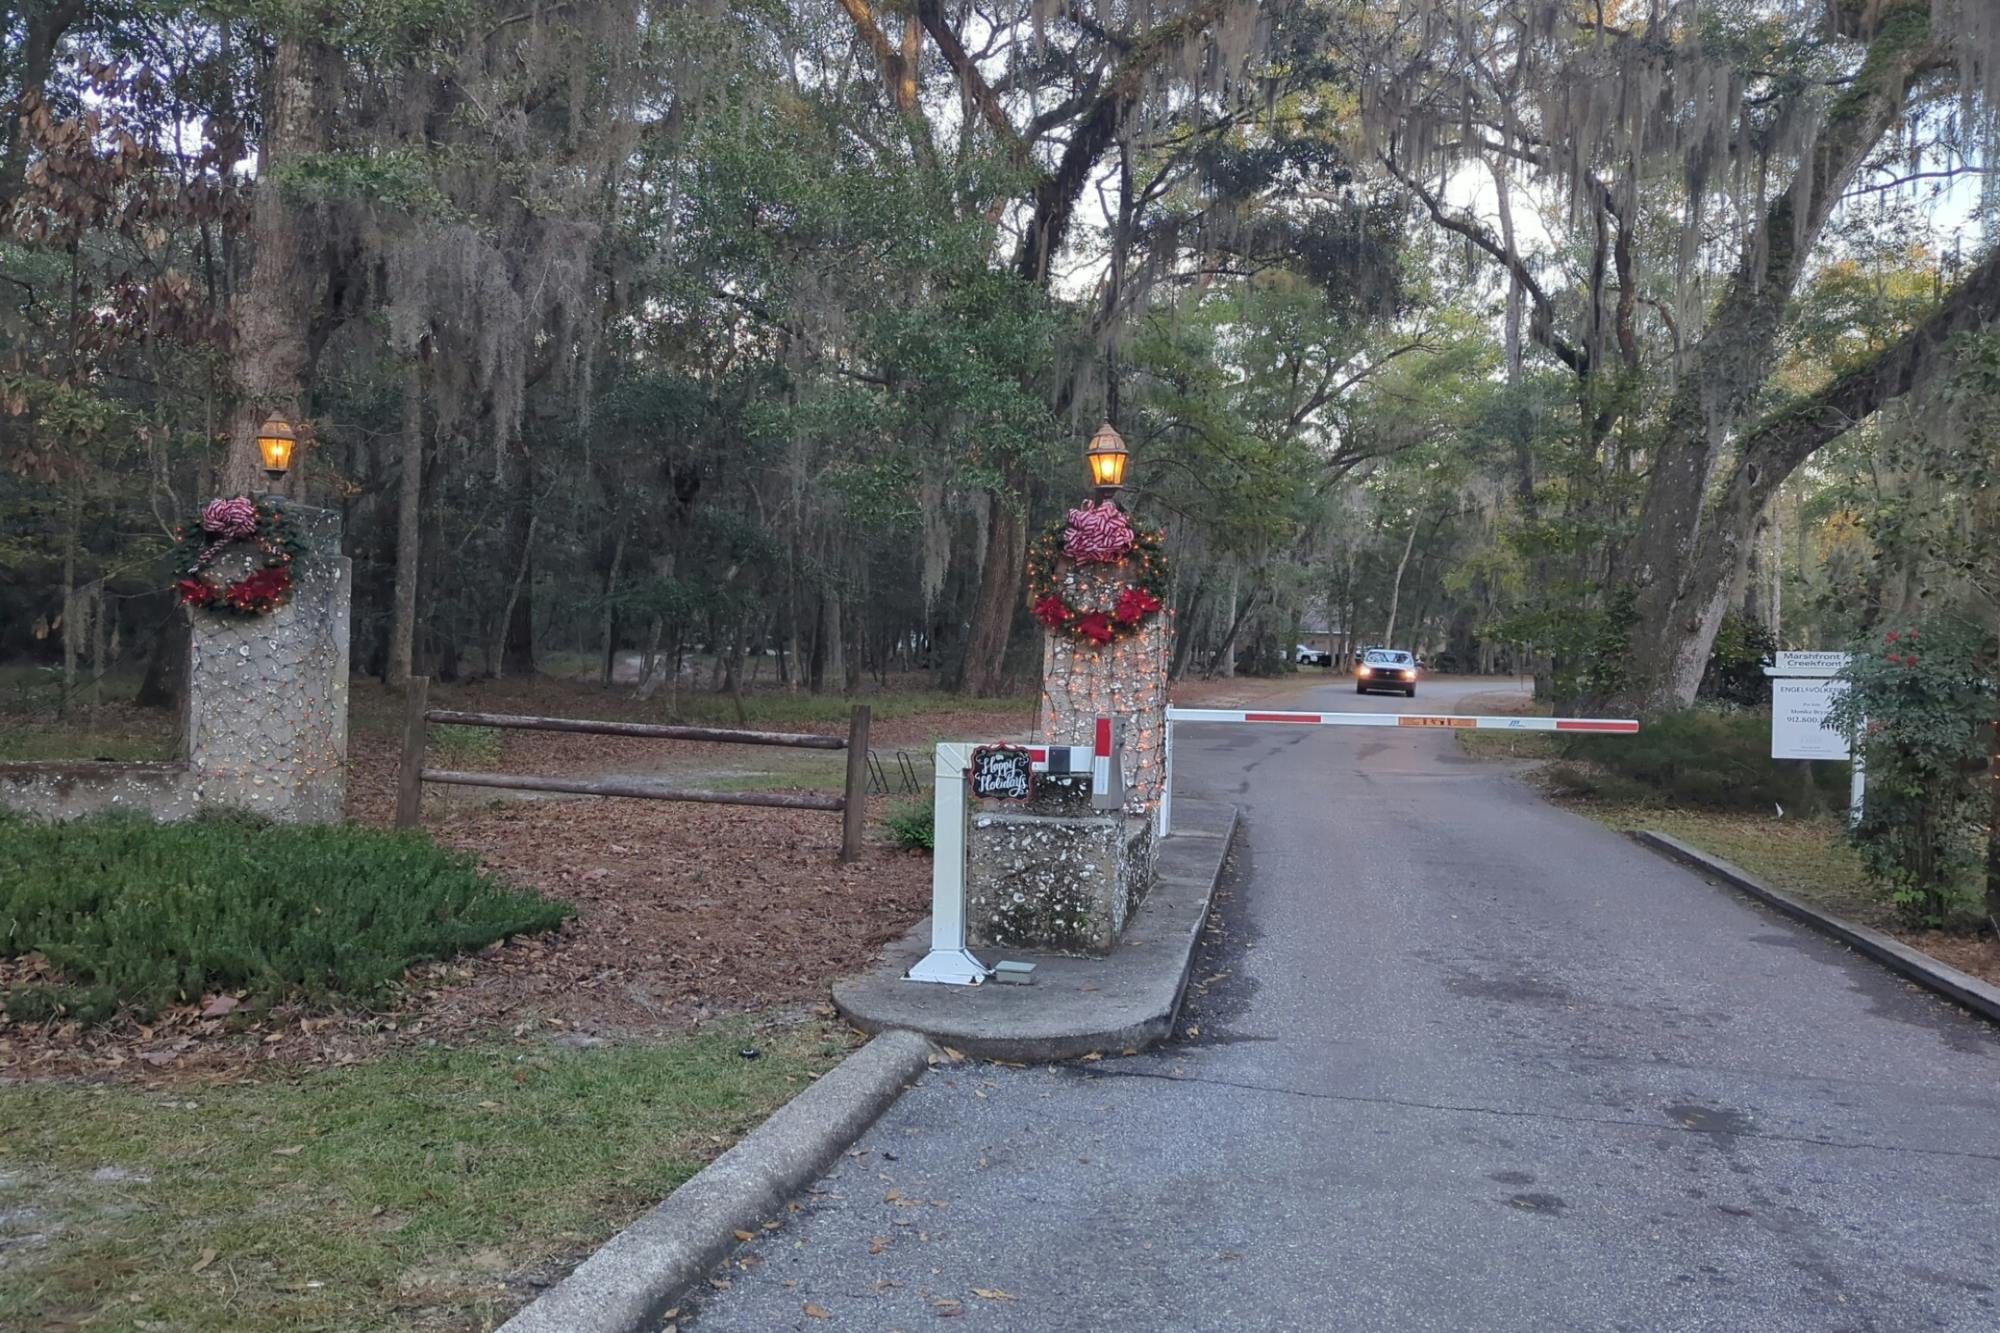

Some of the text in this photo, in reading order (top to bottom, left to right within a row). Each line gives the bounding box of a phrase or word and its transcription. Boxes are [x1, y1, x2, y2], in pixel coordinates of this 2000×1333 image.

[1783, 652, 1841, 660] Marshfront
[1787, 659, 1842, 667] Creekfront
[981, 756, 1018, 777] Happy
[978, 772, 1026, 797] Holidays
